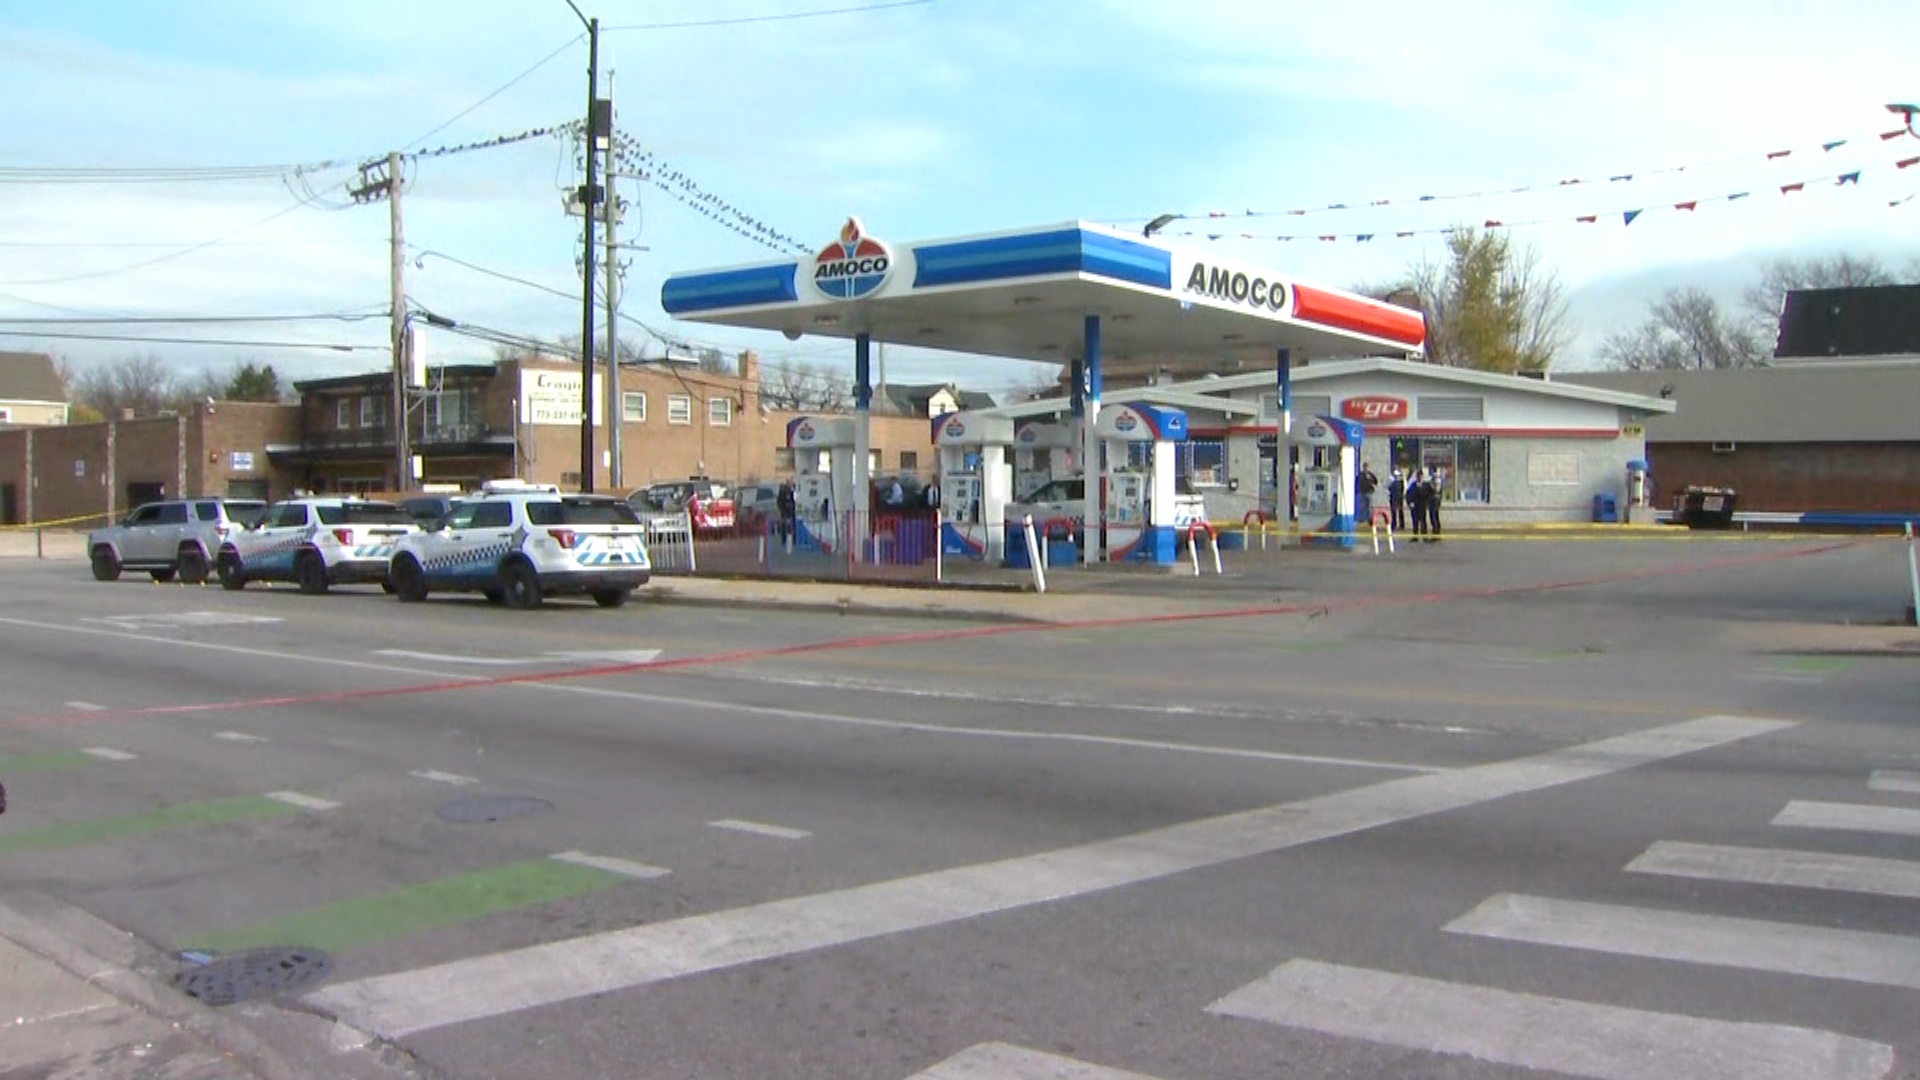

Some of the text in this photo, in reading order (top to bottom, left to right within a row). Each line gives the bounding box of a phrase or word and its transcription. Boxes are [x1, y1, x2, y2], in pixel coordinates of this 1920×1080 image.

[815, 258, 888, 279] AMOCO
[1185, 262, 1286, 310] AMOCO
[1364, 402, 1399, 418] go
